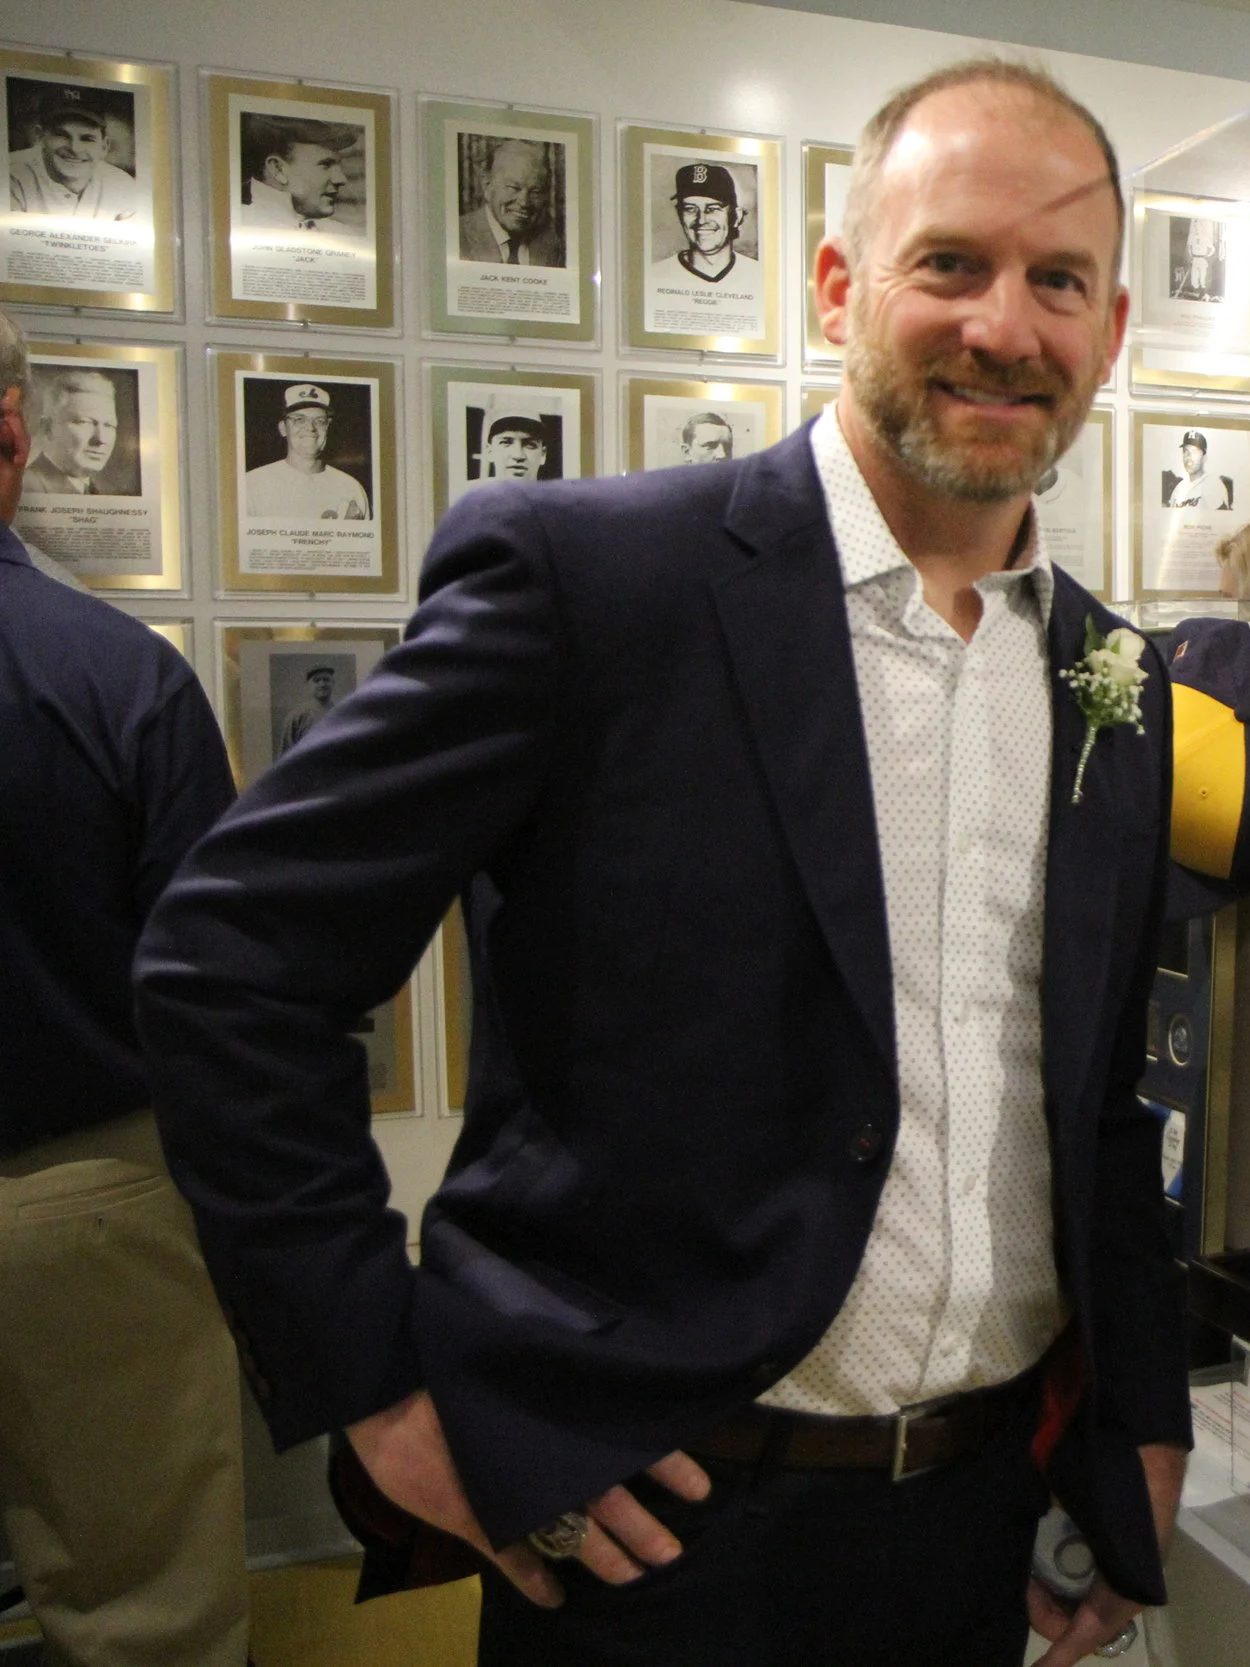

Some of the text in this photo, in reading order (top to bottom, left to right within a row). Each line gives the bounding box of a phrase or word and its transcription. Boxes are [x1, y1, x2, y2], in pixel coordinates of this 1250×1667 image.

[692, 165, 708, 184] B
[9, 228, 46, 238] GEORGE
[49, 231, 101, 242] ALEXANDER
[480, 274, 548, 286] JACK KENT COOKE
[715, 292, 754, 301] CLEVELAND
[50, 506, 85, 515] JOSEPH
[247, 528, 375, 540] JOSEPH CLAUDE MARC RAYMOND
